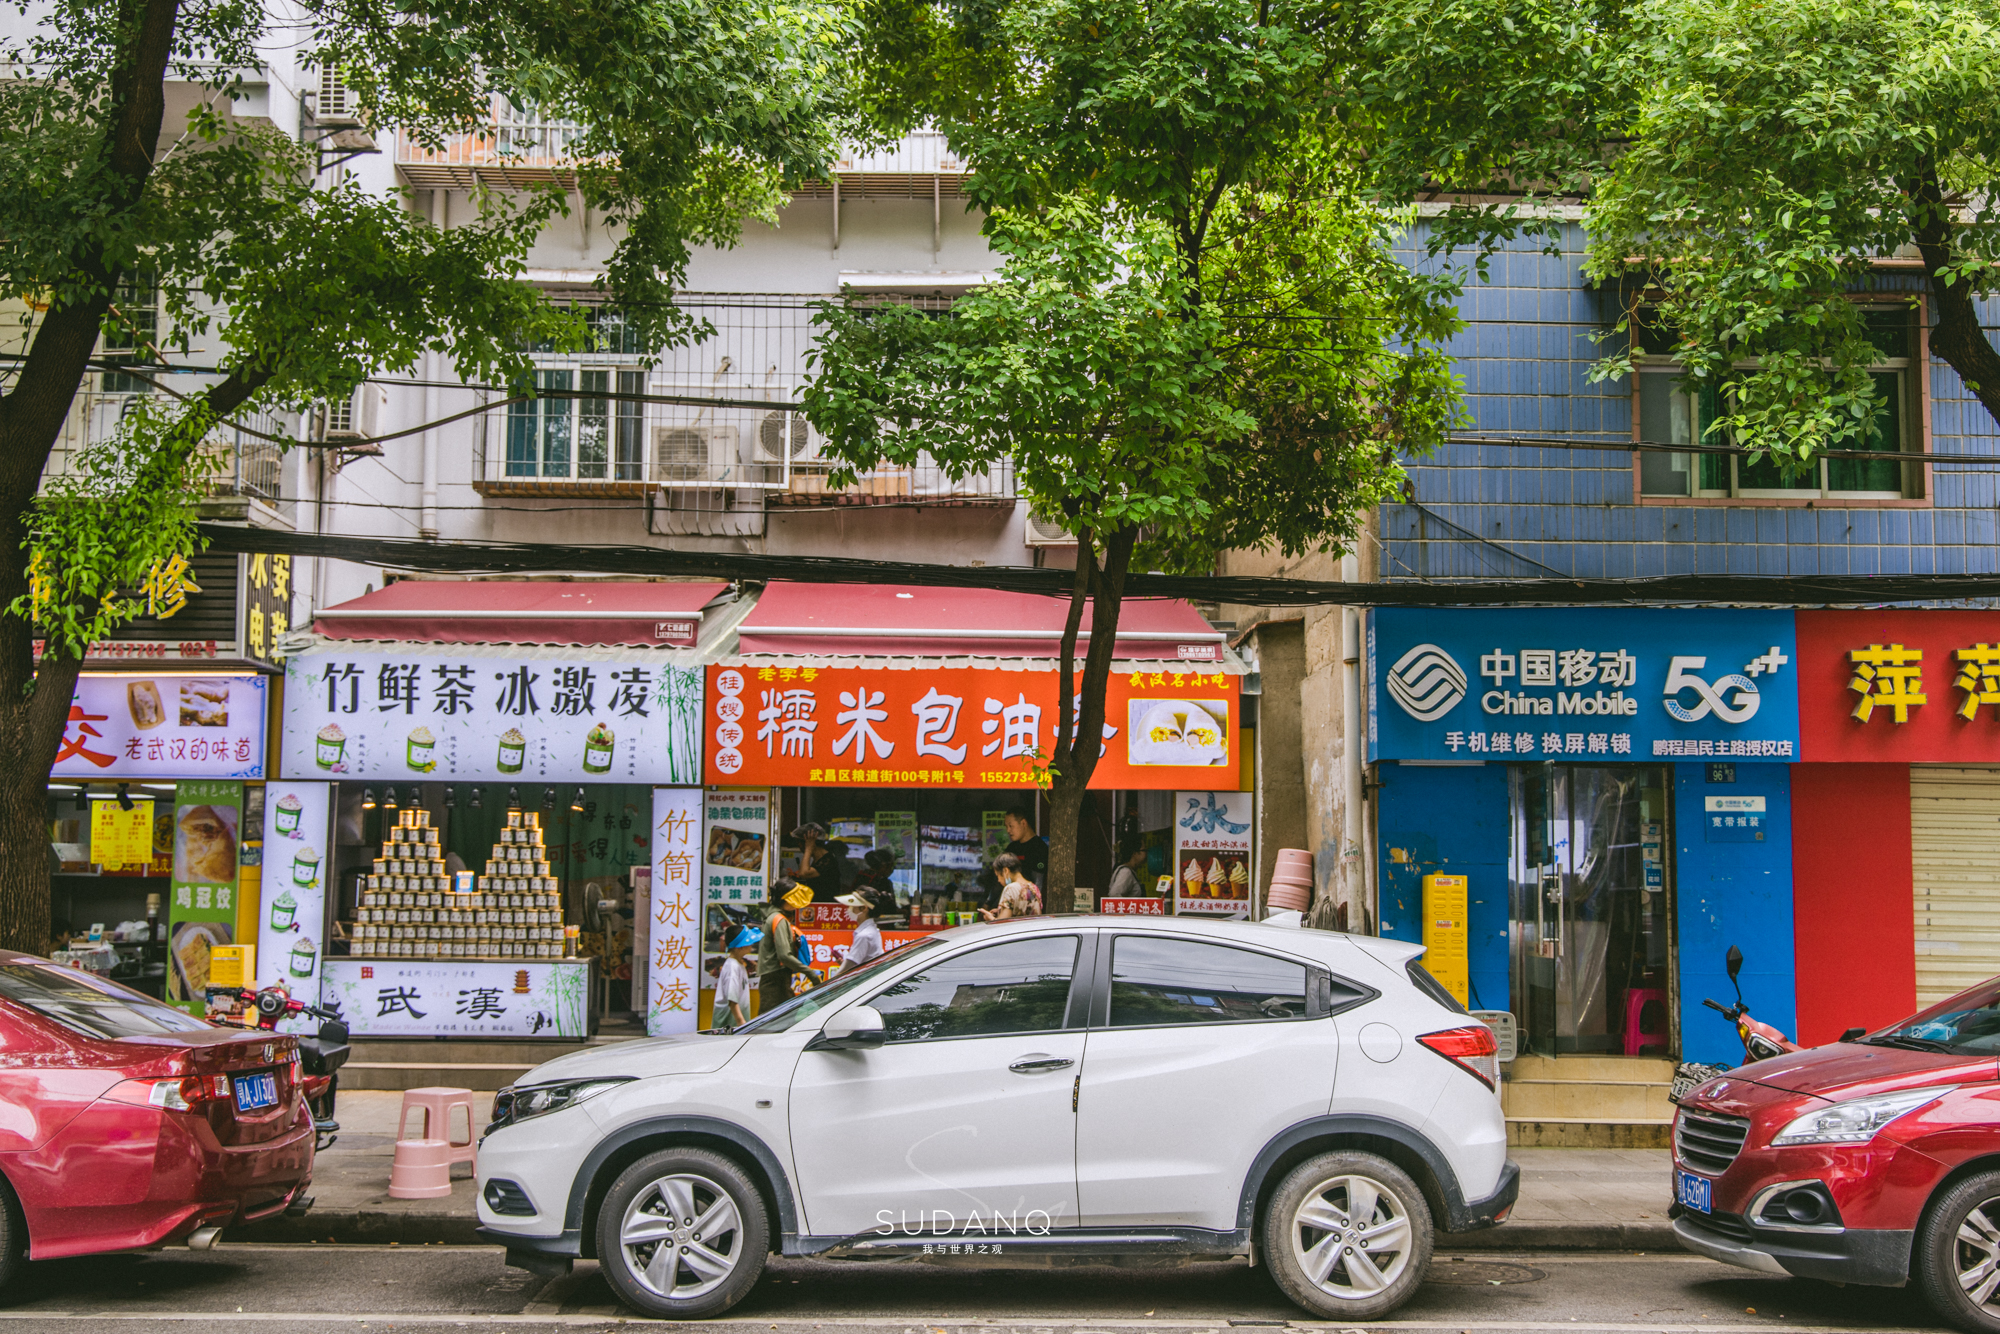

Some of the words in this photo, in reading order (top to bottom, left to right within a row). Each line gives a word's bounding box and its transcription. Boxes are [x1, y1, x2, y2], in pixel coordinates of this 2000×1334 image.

[758, 667, 819, 682] 老字号
[1480, 648, 1637, 687] 中国移动
[1129, 673, 1230, 689] 武汉名小吃
[1481, 691, 1553, 715] China
[1558, 691, 1638, 715] Mobile
[717, 674, 742, 770] 桂嫂传统
[125, 736, 251, 762] 老武汉的味道
[1445, 731, 1535, 754] 手机维修
[1541, 731, 1632, 754] 换屏解锁
[1652, 739, 1793, 757] 鹏程昌民主路授权店
[809, 768, 966, 784] 武昌区粮道街100号附1号
[1713, 770, 1723, 781] 96
[1180, 791, 1250, 835] 冰
[1712, 817, 1760, 828] 宽带报装
[176, 886, 232, 910] 鸡冠饺
[655, 808, 696, 1014] 竹筒冰激凌
[377, 986, 507, 1020] 武漢
